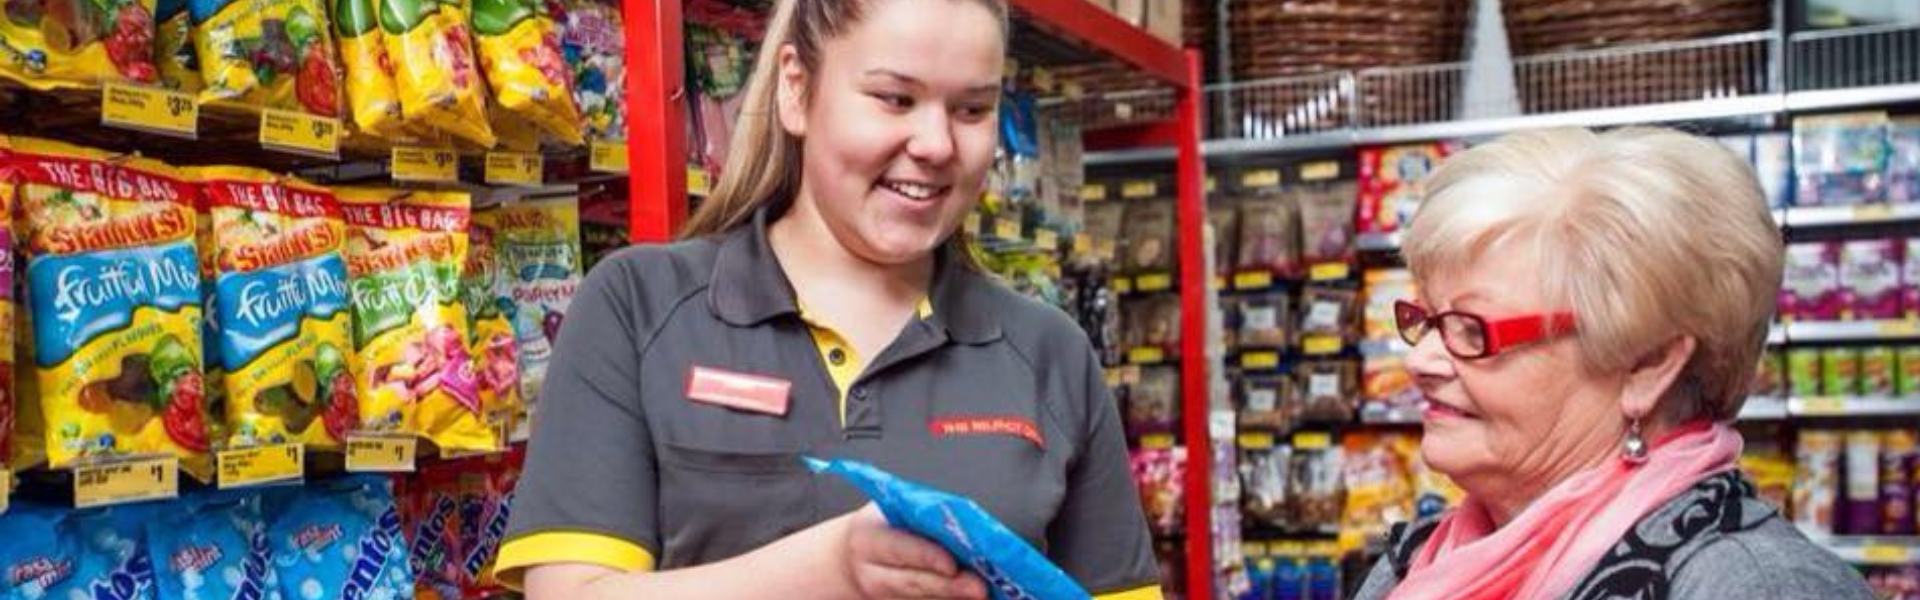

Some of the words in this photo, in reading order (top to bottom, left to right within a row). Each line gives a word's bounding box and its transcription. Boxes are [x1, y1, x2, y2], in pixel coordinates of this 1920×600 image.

[38, 161, 84, 188] THE
[90, 163, 133, 198] BIG
[227, 183, 263, 209] THE
[342, 205, 377, 225] THE
[380, 203, 418, 228] BIG
[340, 504, 403, 600] entos
[410, 496, 455, 577] entos
